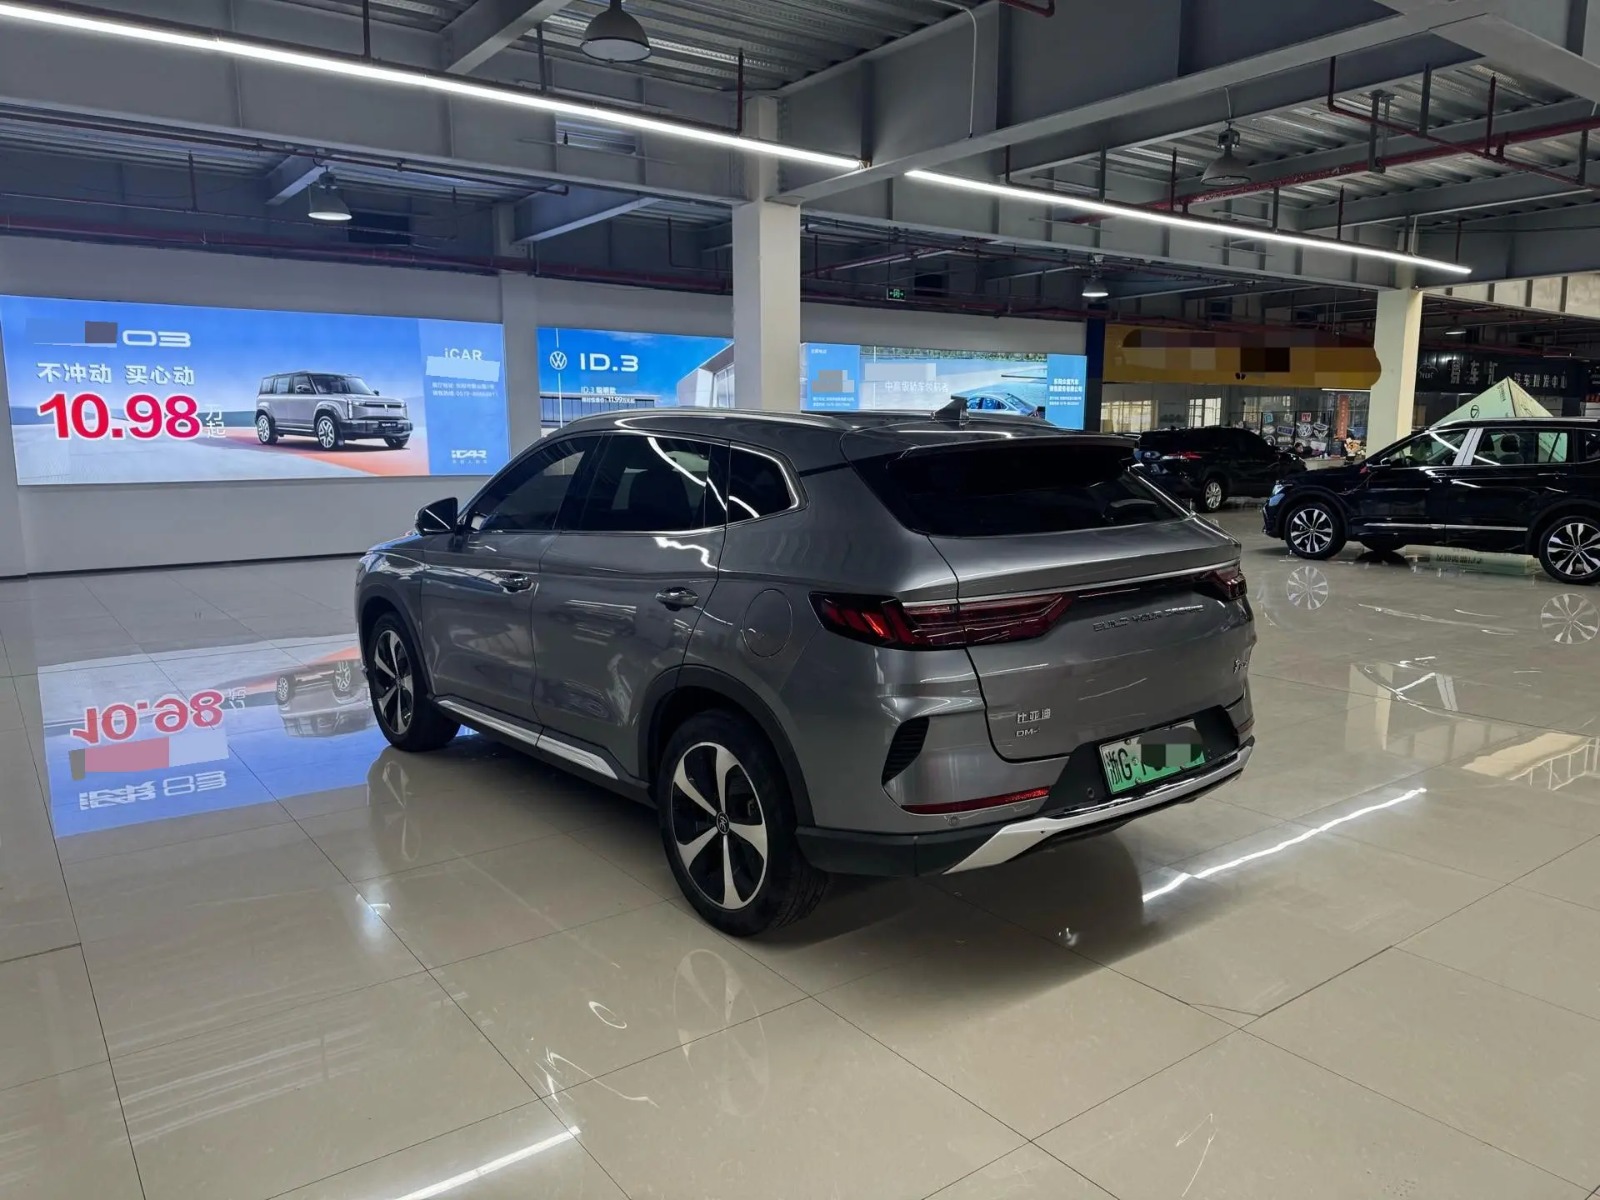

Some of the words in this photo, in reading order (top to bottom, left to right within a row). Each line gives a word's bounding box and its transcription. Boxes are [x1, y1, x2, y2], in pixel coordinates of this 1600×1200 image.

[579, 352, 639, 373] ID.3
[37, 362, 112, 384] 不冲动
[125, 364, 196, 386] 买心动
[37, 392, 202, 441] 10.98
[1017, 708, 1051, 724] 比亚迪
